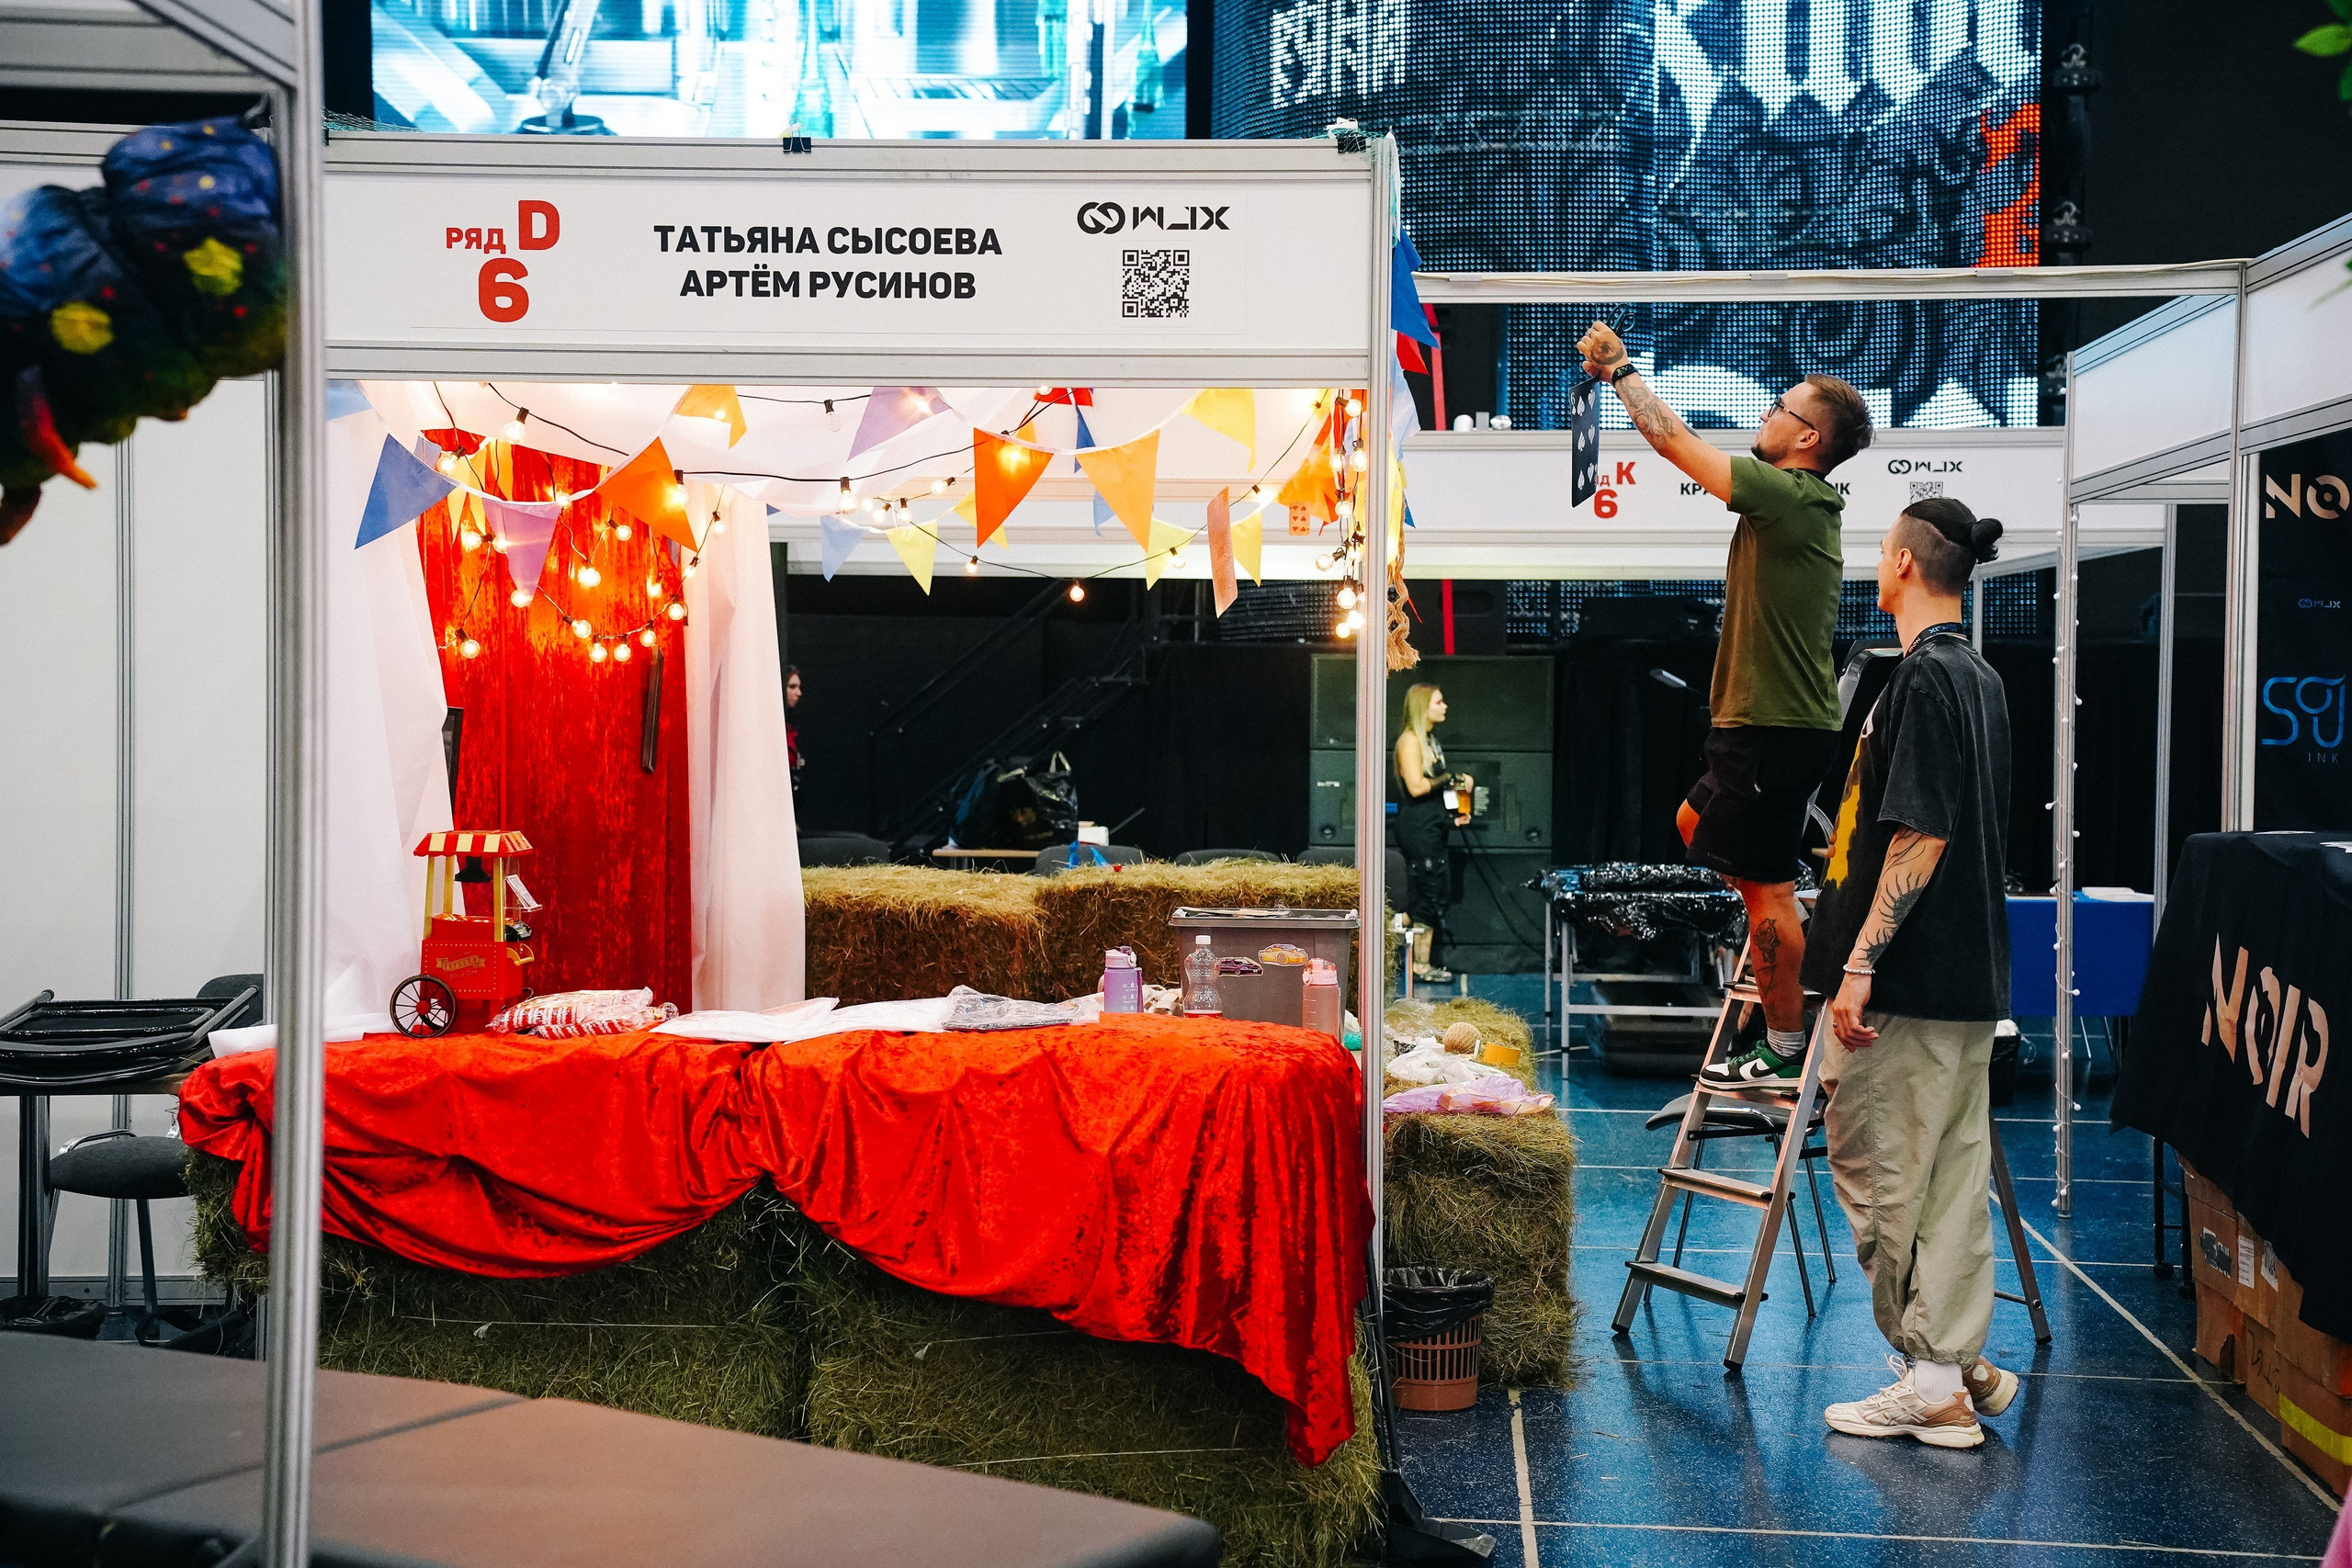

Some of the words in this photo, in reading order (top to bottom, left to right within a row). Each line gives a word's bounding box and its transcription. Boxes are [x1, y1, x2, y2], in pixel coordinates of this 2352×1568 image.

[518, 200, 560, 251] D
[653, 225, 820, 254] ТАТЬЯНА
[827, 227, 1002, 255] СЫСОЕВА
[478, 257, 530, 323] 6
[680, 263, 800, 298] АРТЁМ
[809, 271, 977, 299] РУСИНОВ
[1594, 489, 1618, 519] 6
[2266, 473, 2350, 520] NO
[2308, 752, 2339, 764] INK
[2201, 931, 2329, 1139] NOIR
